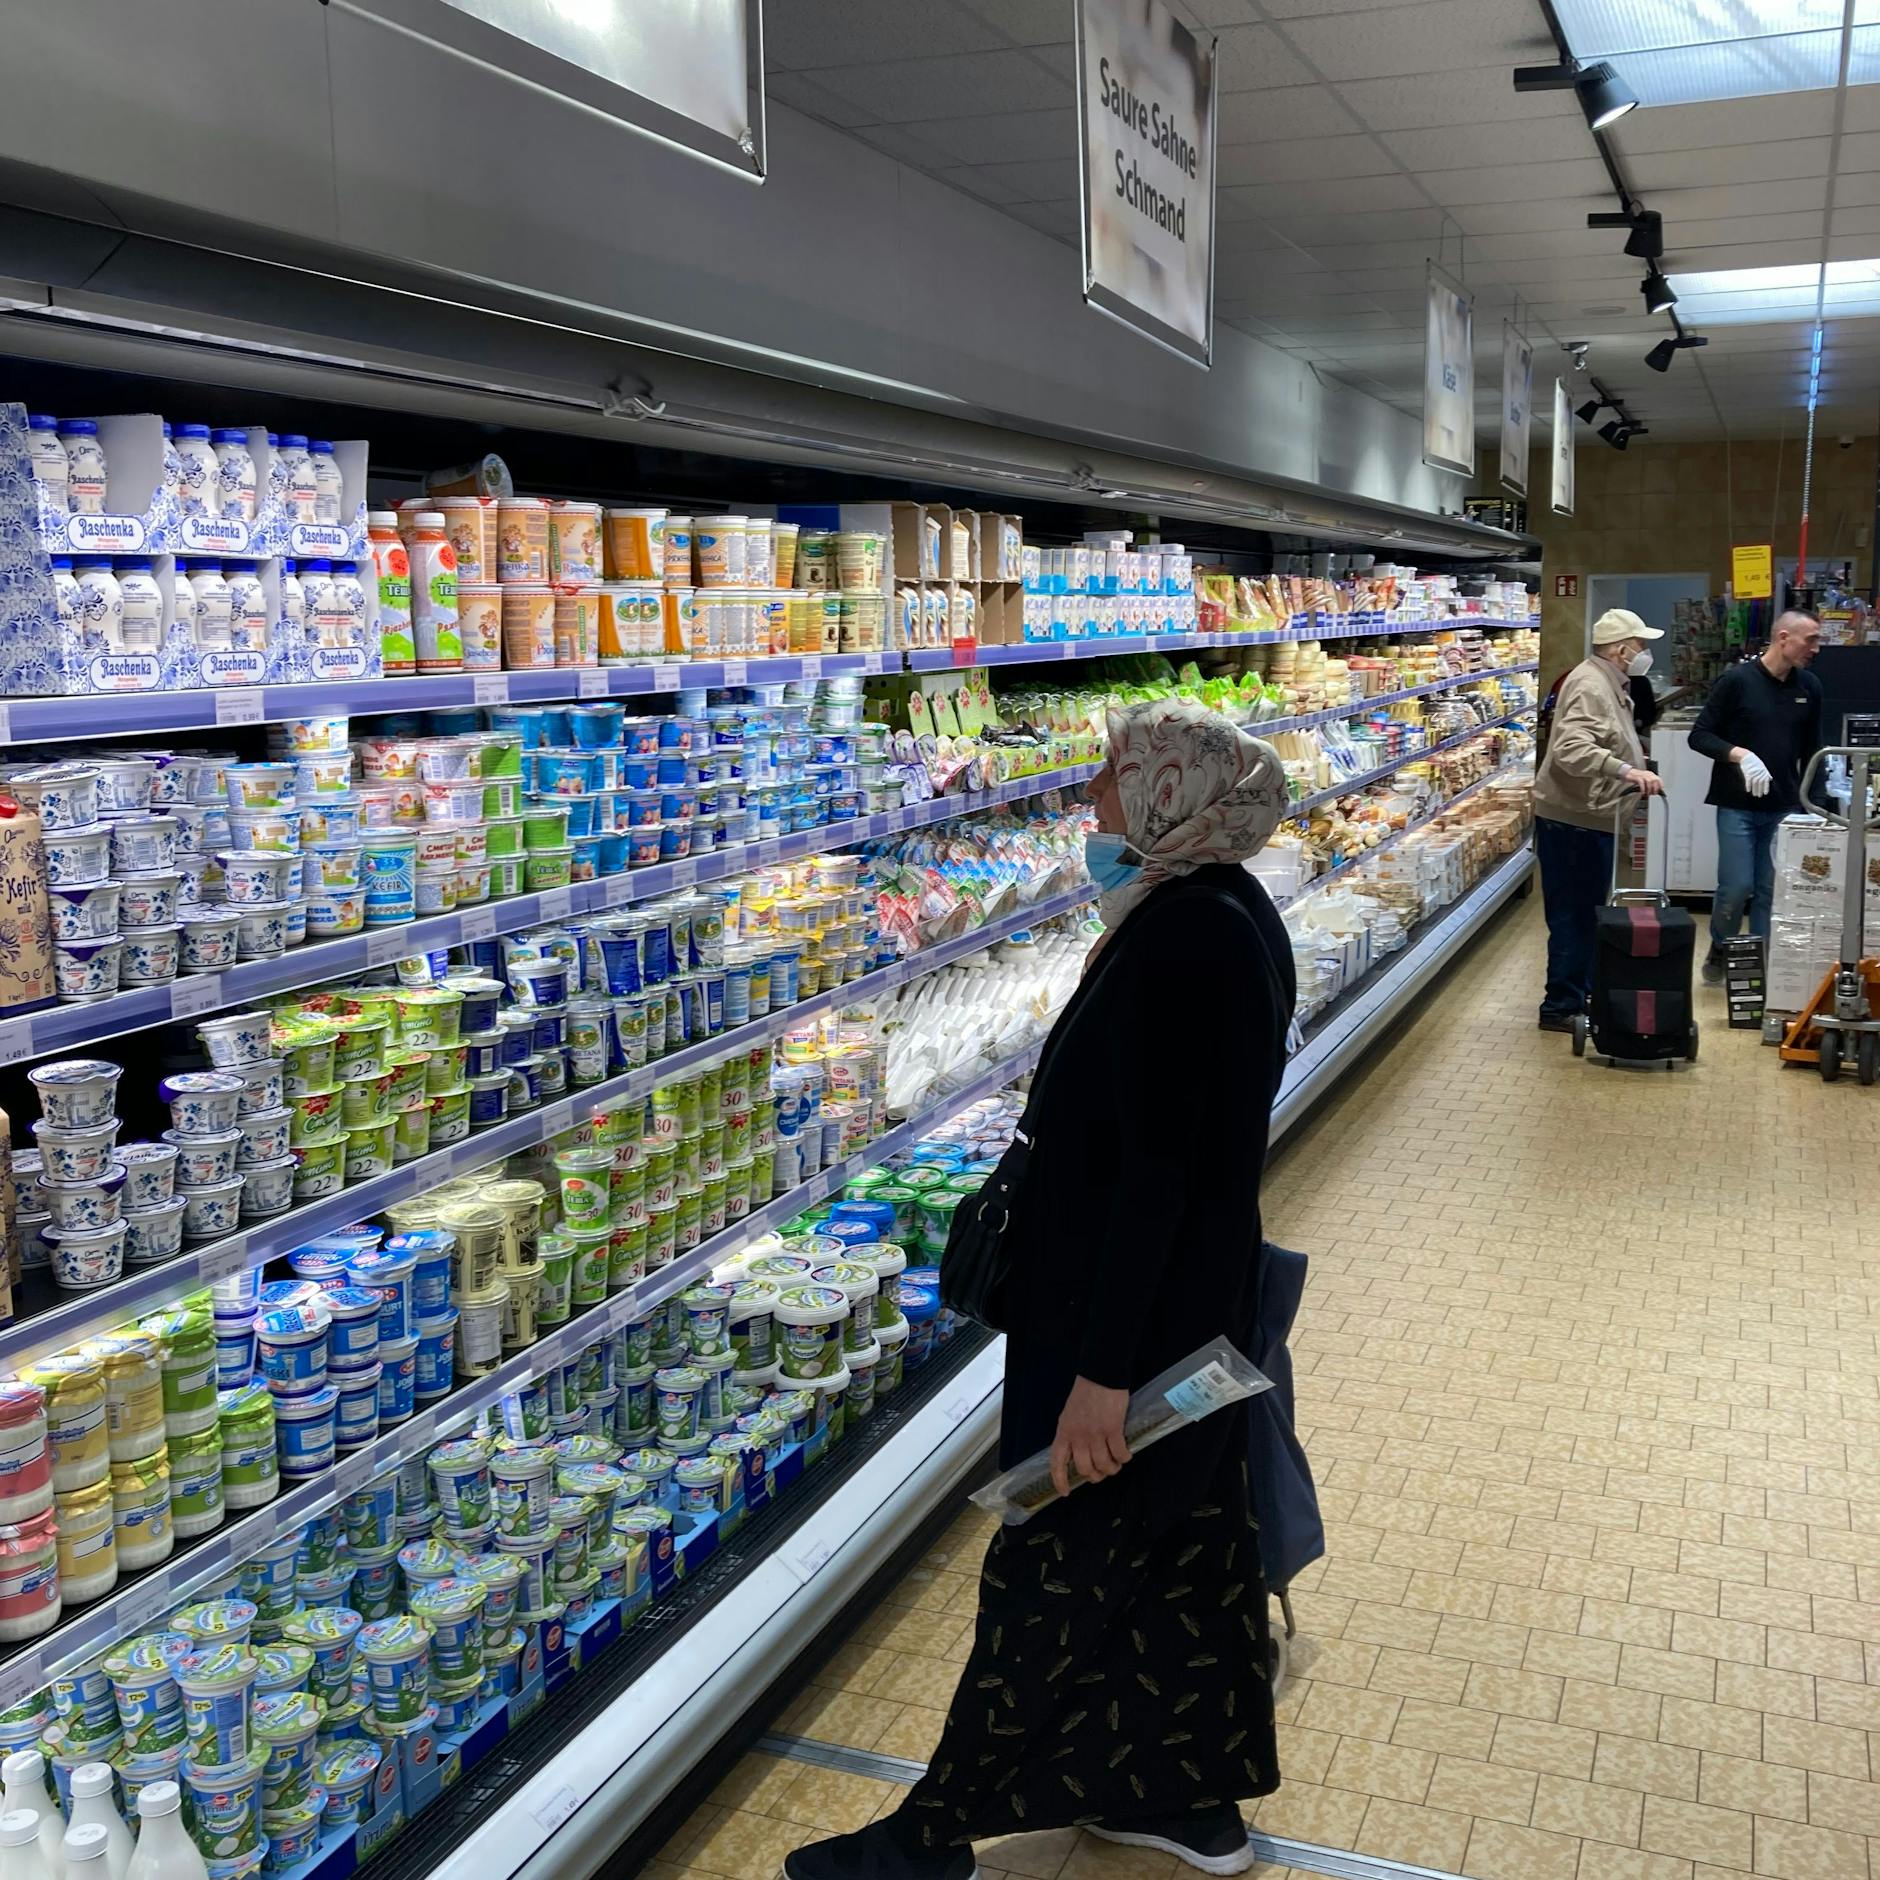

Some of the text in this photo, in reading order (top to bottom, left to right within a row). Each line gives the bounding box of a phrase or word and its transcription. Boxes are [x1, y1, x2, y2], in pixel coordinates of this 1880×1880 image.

[1099, 56, 1197, 181] Saure Sahne
[1114, 148, 1186, 244] Schmand
[79, 518, 134, 538] Raschenka
[192, 519, 240, 539] Raschenka
[300, 527, 341, 545] Raschenka
[101, 658, 151, 679] Raschenka
[211, 653, 257, 674] Raschenka
[320, 651, 359, 669] Raschenka
[6, 873, 38, 905] Kefir
[372, 880, 403, 891] KEFIR
[17, 902, 32, 915] mild
[6, 1049, 21, 1060] 1,49
[57, 1684, 74, 1692] 12%
[129, 1691, 147, 1702] 12%
[194, 1702, 211, 1710] 12%
[278, 1748, 298, 1758] 12%
